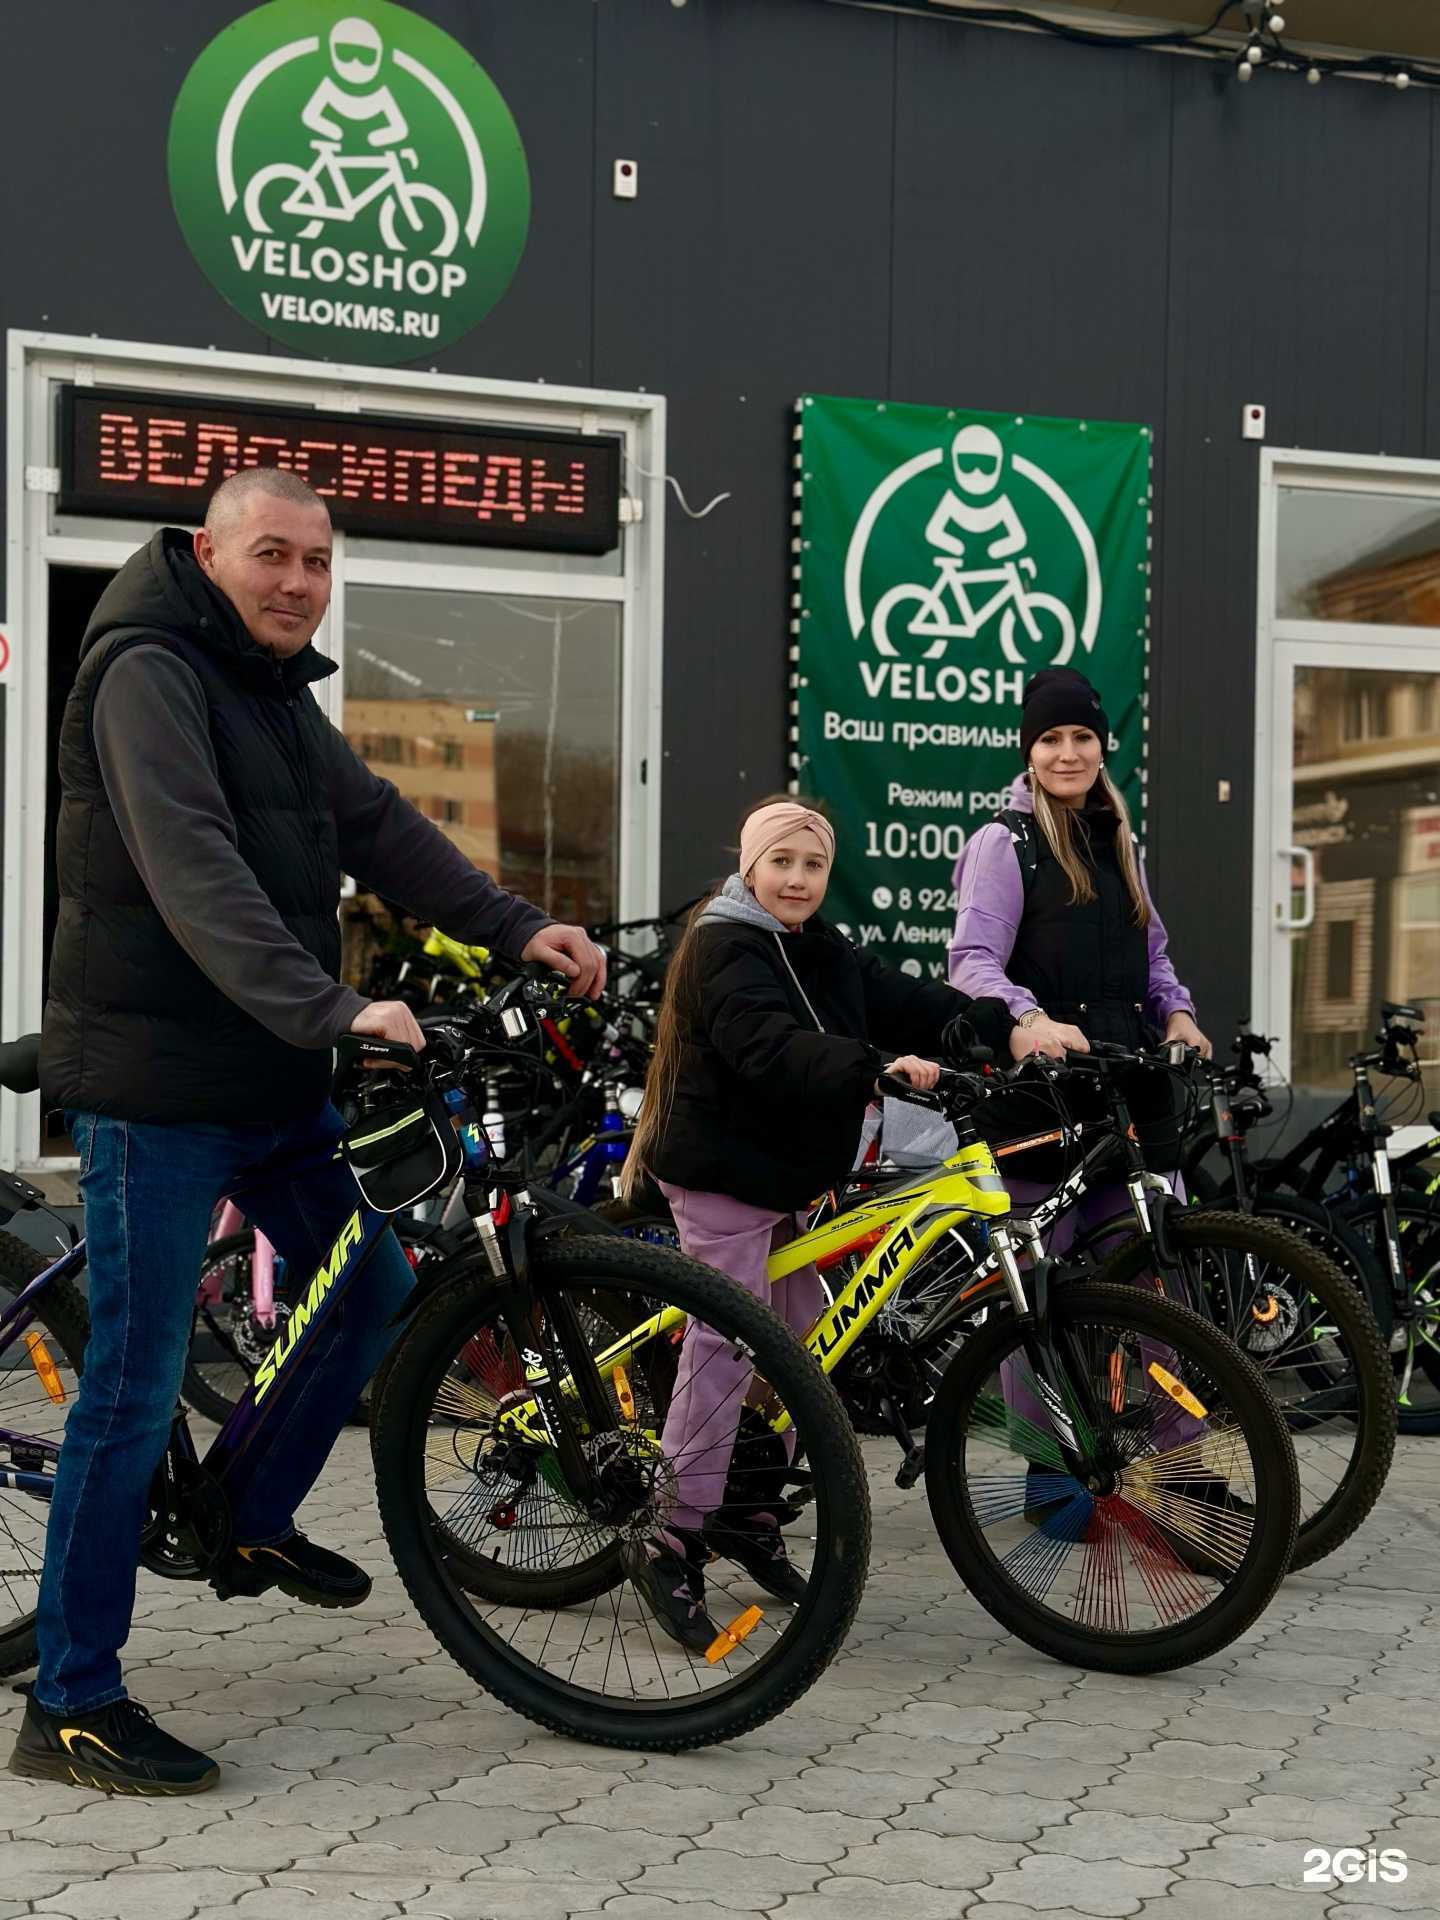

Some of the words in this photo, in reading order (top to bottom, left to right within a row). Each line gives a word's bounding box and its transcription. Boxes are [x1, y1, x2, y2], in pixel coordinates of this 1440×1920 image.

[231, 235, 467, 298] VELOSHOP
[260, 292, 440, 338] VELOKMS.RU
[858, 661, 1024, 706] VELOSH
[824, 711, 885, 743] Ваш
[892, 721, 1021, 751] правильн
[887, 782, 963, 809] Режим
[969, 785, 1014, 815] раб
[864, 821, 965, 861] 10:00
[898, 888, 913, 911] 8
[892, 920, 953, 944] Лени
[254, 1208, 365, 1406] SUMMA
